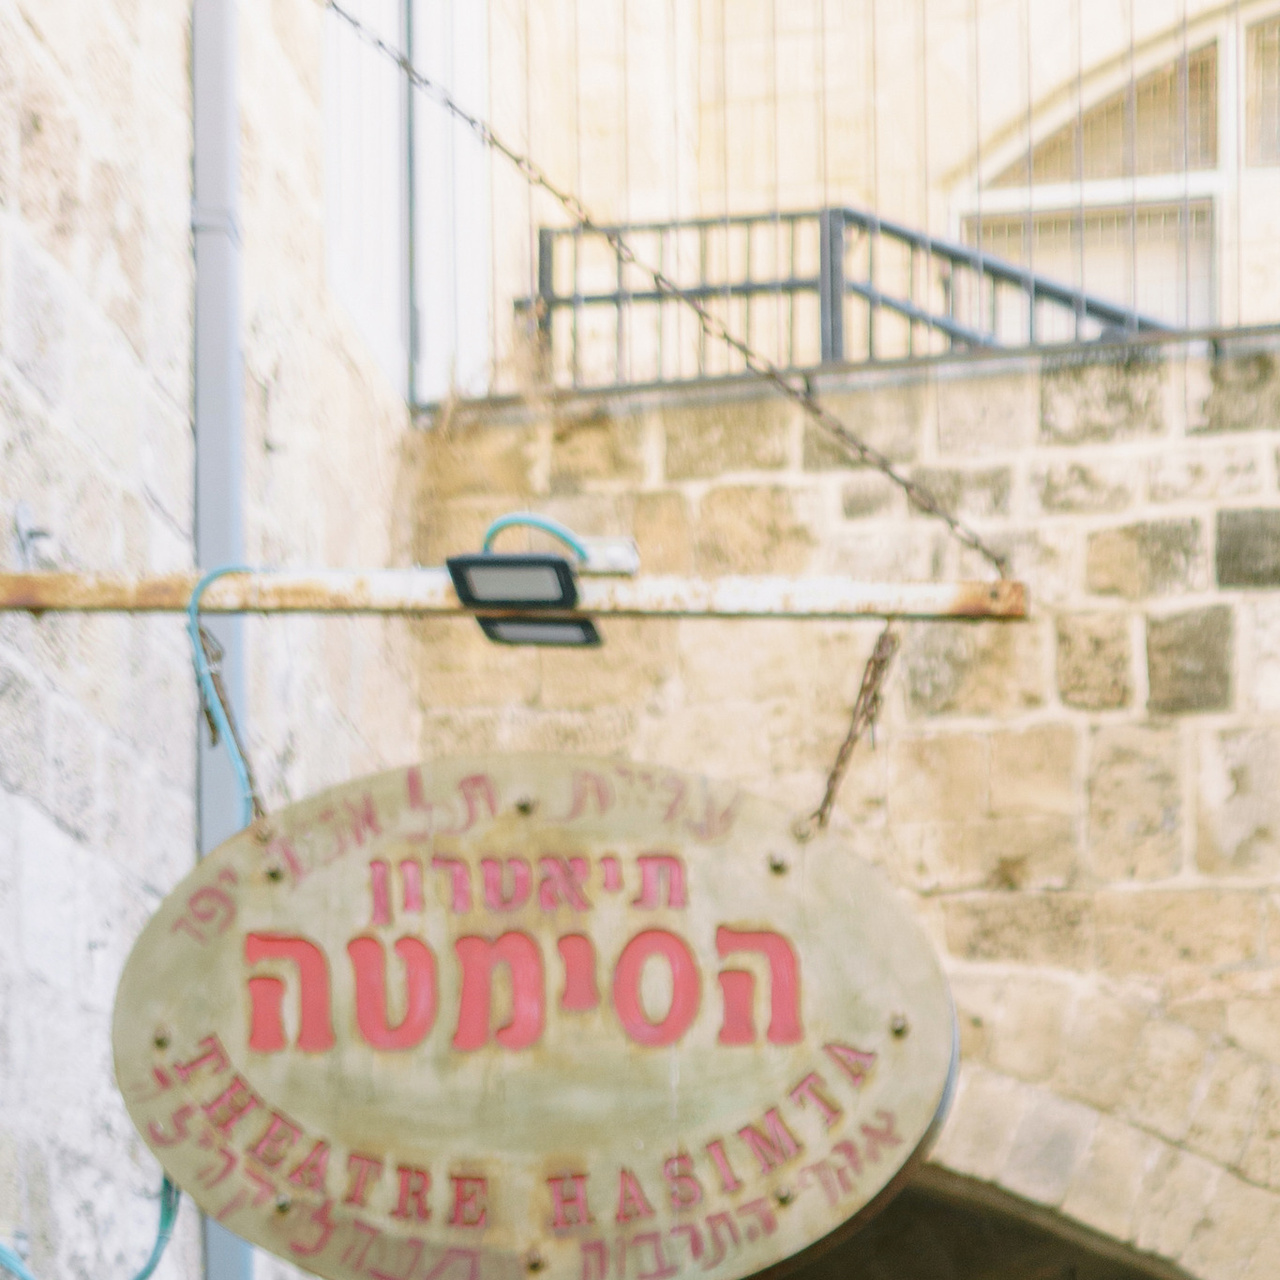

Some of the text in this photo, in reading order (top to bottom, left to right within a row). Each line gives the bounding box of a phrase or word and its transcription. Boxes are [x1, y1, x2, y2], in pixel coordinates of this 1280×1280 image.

[405, 766, 498, 843] תל
[171, 866, 238, 944] יפו
[369, 856, 687, 926] תיאטרון
[244, 925, 803, 1054] הסימטה
[173, 1031, 878, 1230] THEATRE HASIMTA
[797, 1110, 904, 1208] אגף
